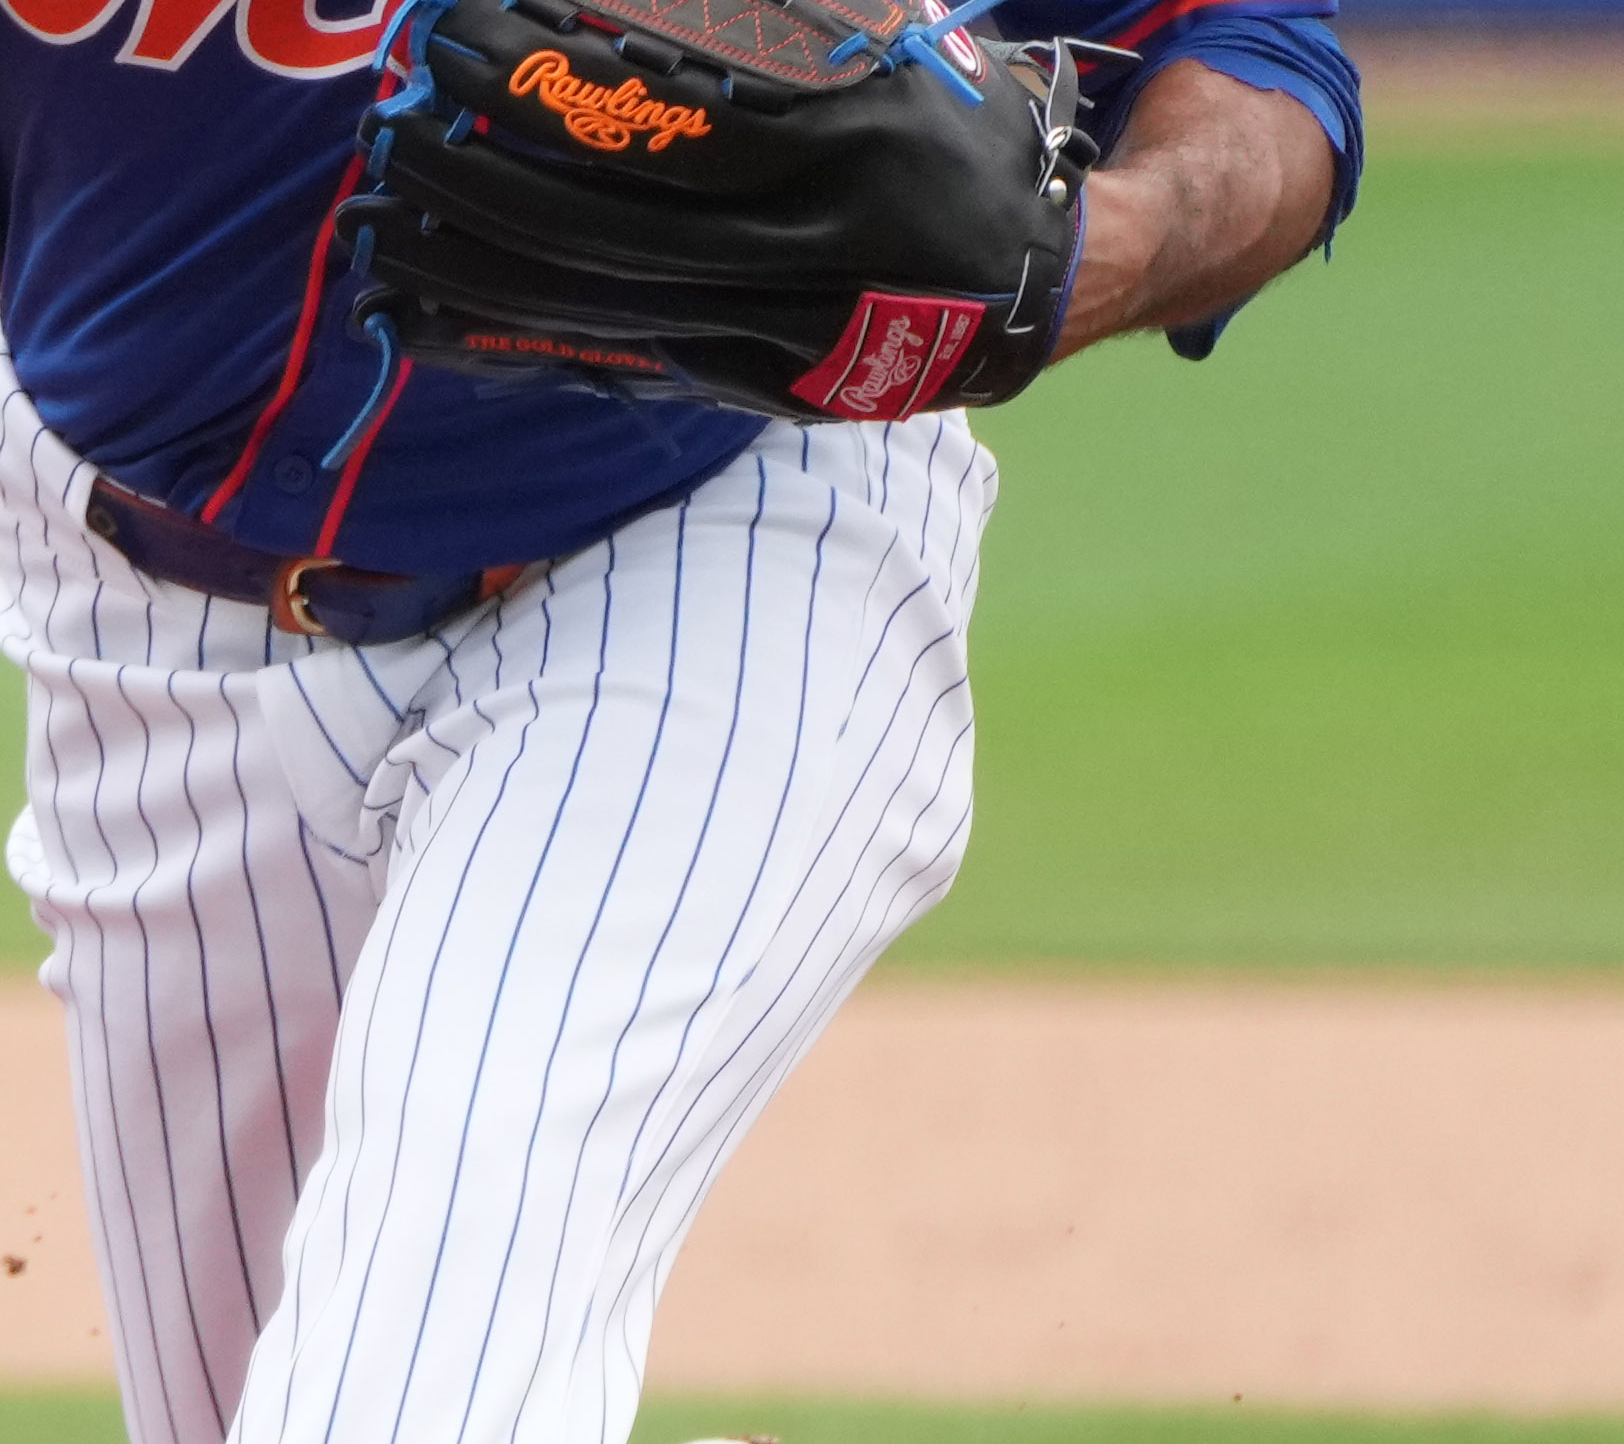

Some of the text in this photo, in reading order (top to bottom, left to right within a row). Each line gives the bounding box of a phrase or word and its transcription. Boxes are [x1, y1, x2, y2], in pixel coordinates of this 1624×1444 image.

[508, 48, 713, 153] Rawlings
[464, 334, 512, 352] THE
[515, 336, 576, 358] GOLD
[839, 314, 924, 413] Rawlings
